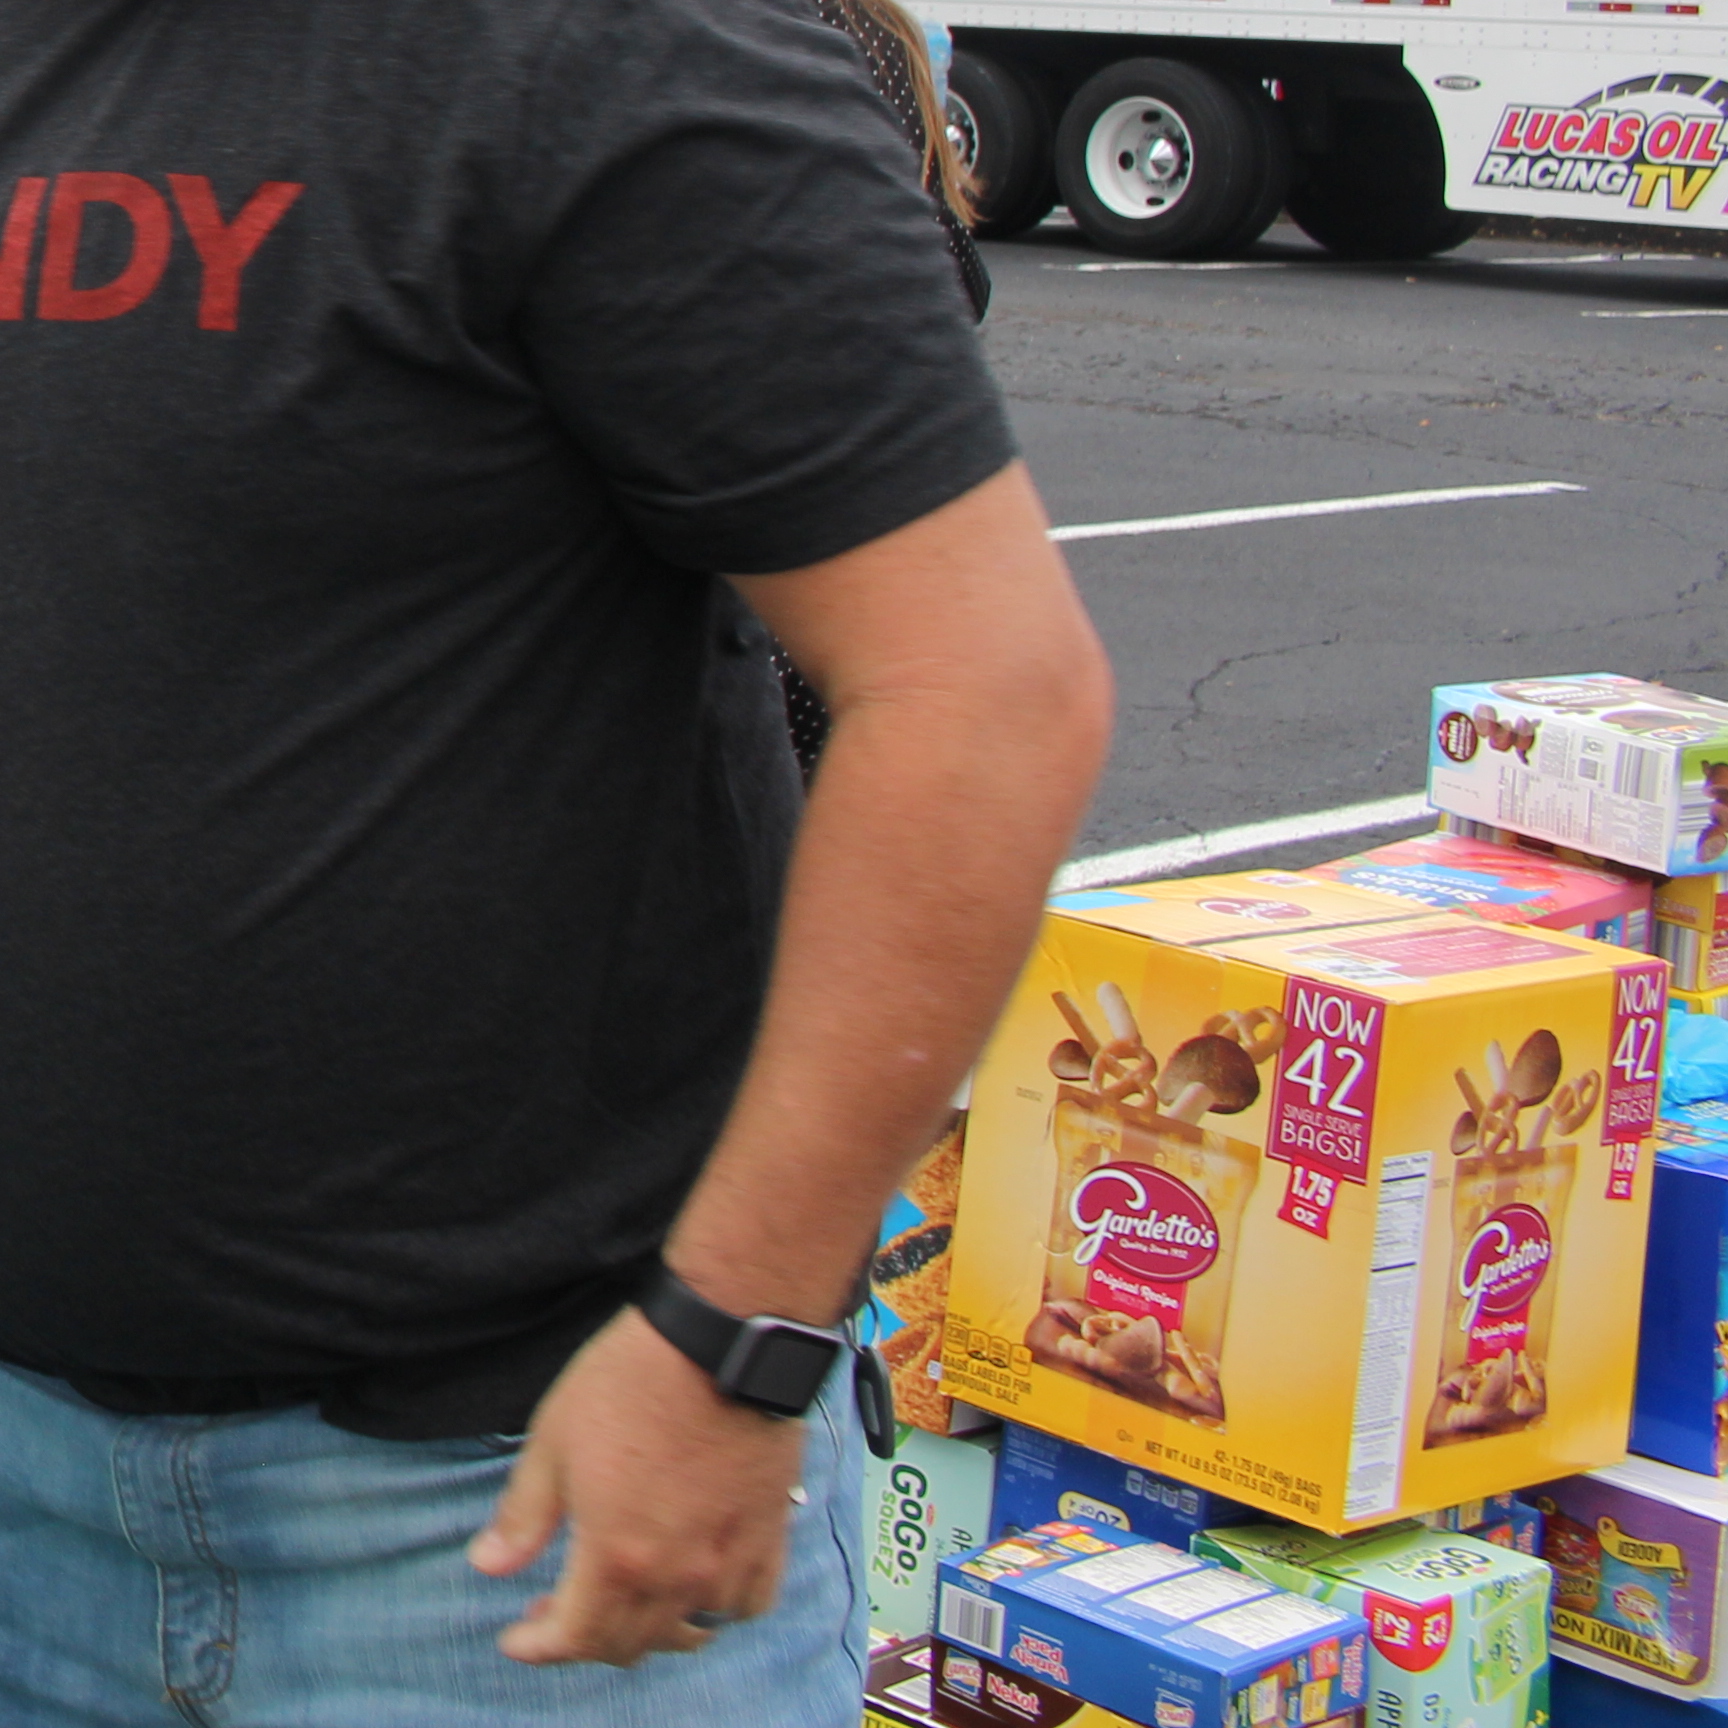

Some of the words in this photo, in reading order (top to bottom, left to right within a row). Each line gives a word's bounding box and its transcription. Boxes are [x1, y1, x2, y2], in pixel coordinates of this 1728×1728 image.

[1496, 111, 1643, 157] LUCAS
[1646, 118, 1718, 162] OIL
[1476, 154, 1629, 194] RACING
[1630, 163, 1714, 210] TV
[1351, 870, 1489, 903] Snacks
[1617, 972, 1664, 1016] NOW
[1293, 987, 1377, 1046] NOW
[1611, 1017, 1657, 1083] 42
[1283, 1038, 1365, 1119] 42
[1279, 1118, 1363, 1165] BAGS!
[1282, 1104, 1322, 1128] SINGLE
[1323, 1111, 1363, 1137] SERVE
[1292, 1165, 1335, 1209] 1.75
[1068, 1168, 1217, 1266] Gardetto's
[1291, 1205, 1319, 1229] OZ
[1092, 1268, 1140, 1295] Original
[1140, 1285, 1180, 1310] Recipe
[1458, 1219, 1553, 1332] Gardetto's
[1180, 1453, 1188, 1464] 4
[1232, 1455, 1253, 1472] 1.75
[1294, 1477, 1322, 1498] BAGS
[1616, 1541, 1663, 1564] ADDED!
[1018, 1632, 1063, 1663] Pack
[1382, 1611, 1412, 1647] 24
[1590, 1621, 1632, 1655] MIX!
[1009, 1645, 1070, 1686] Variety
[986, 1671, 1040, 1715] Nekot
